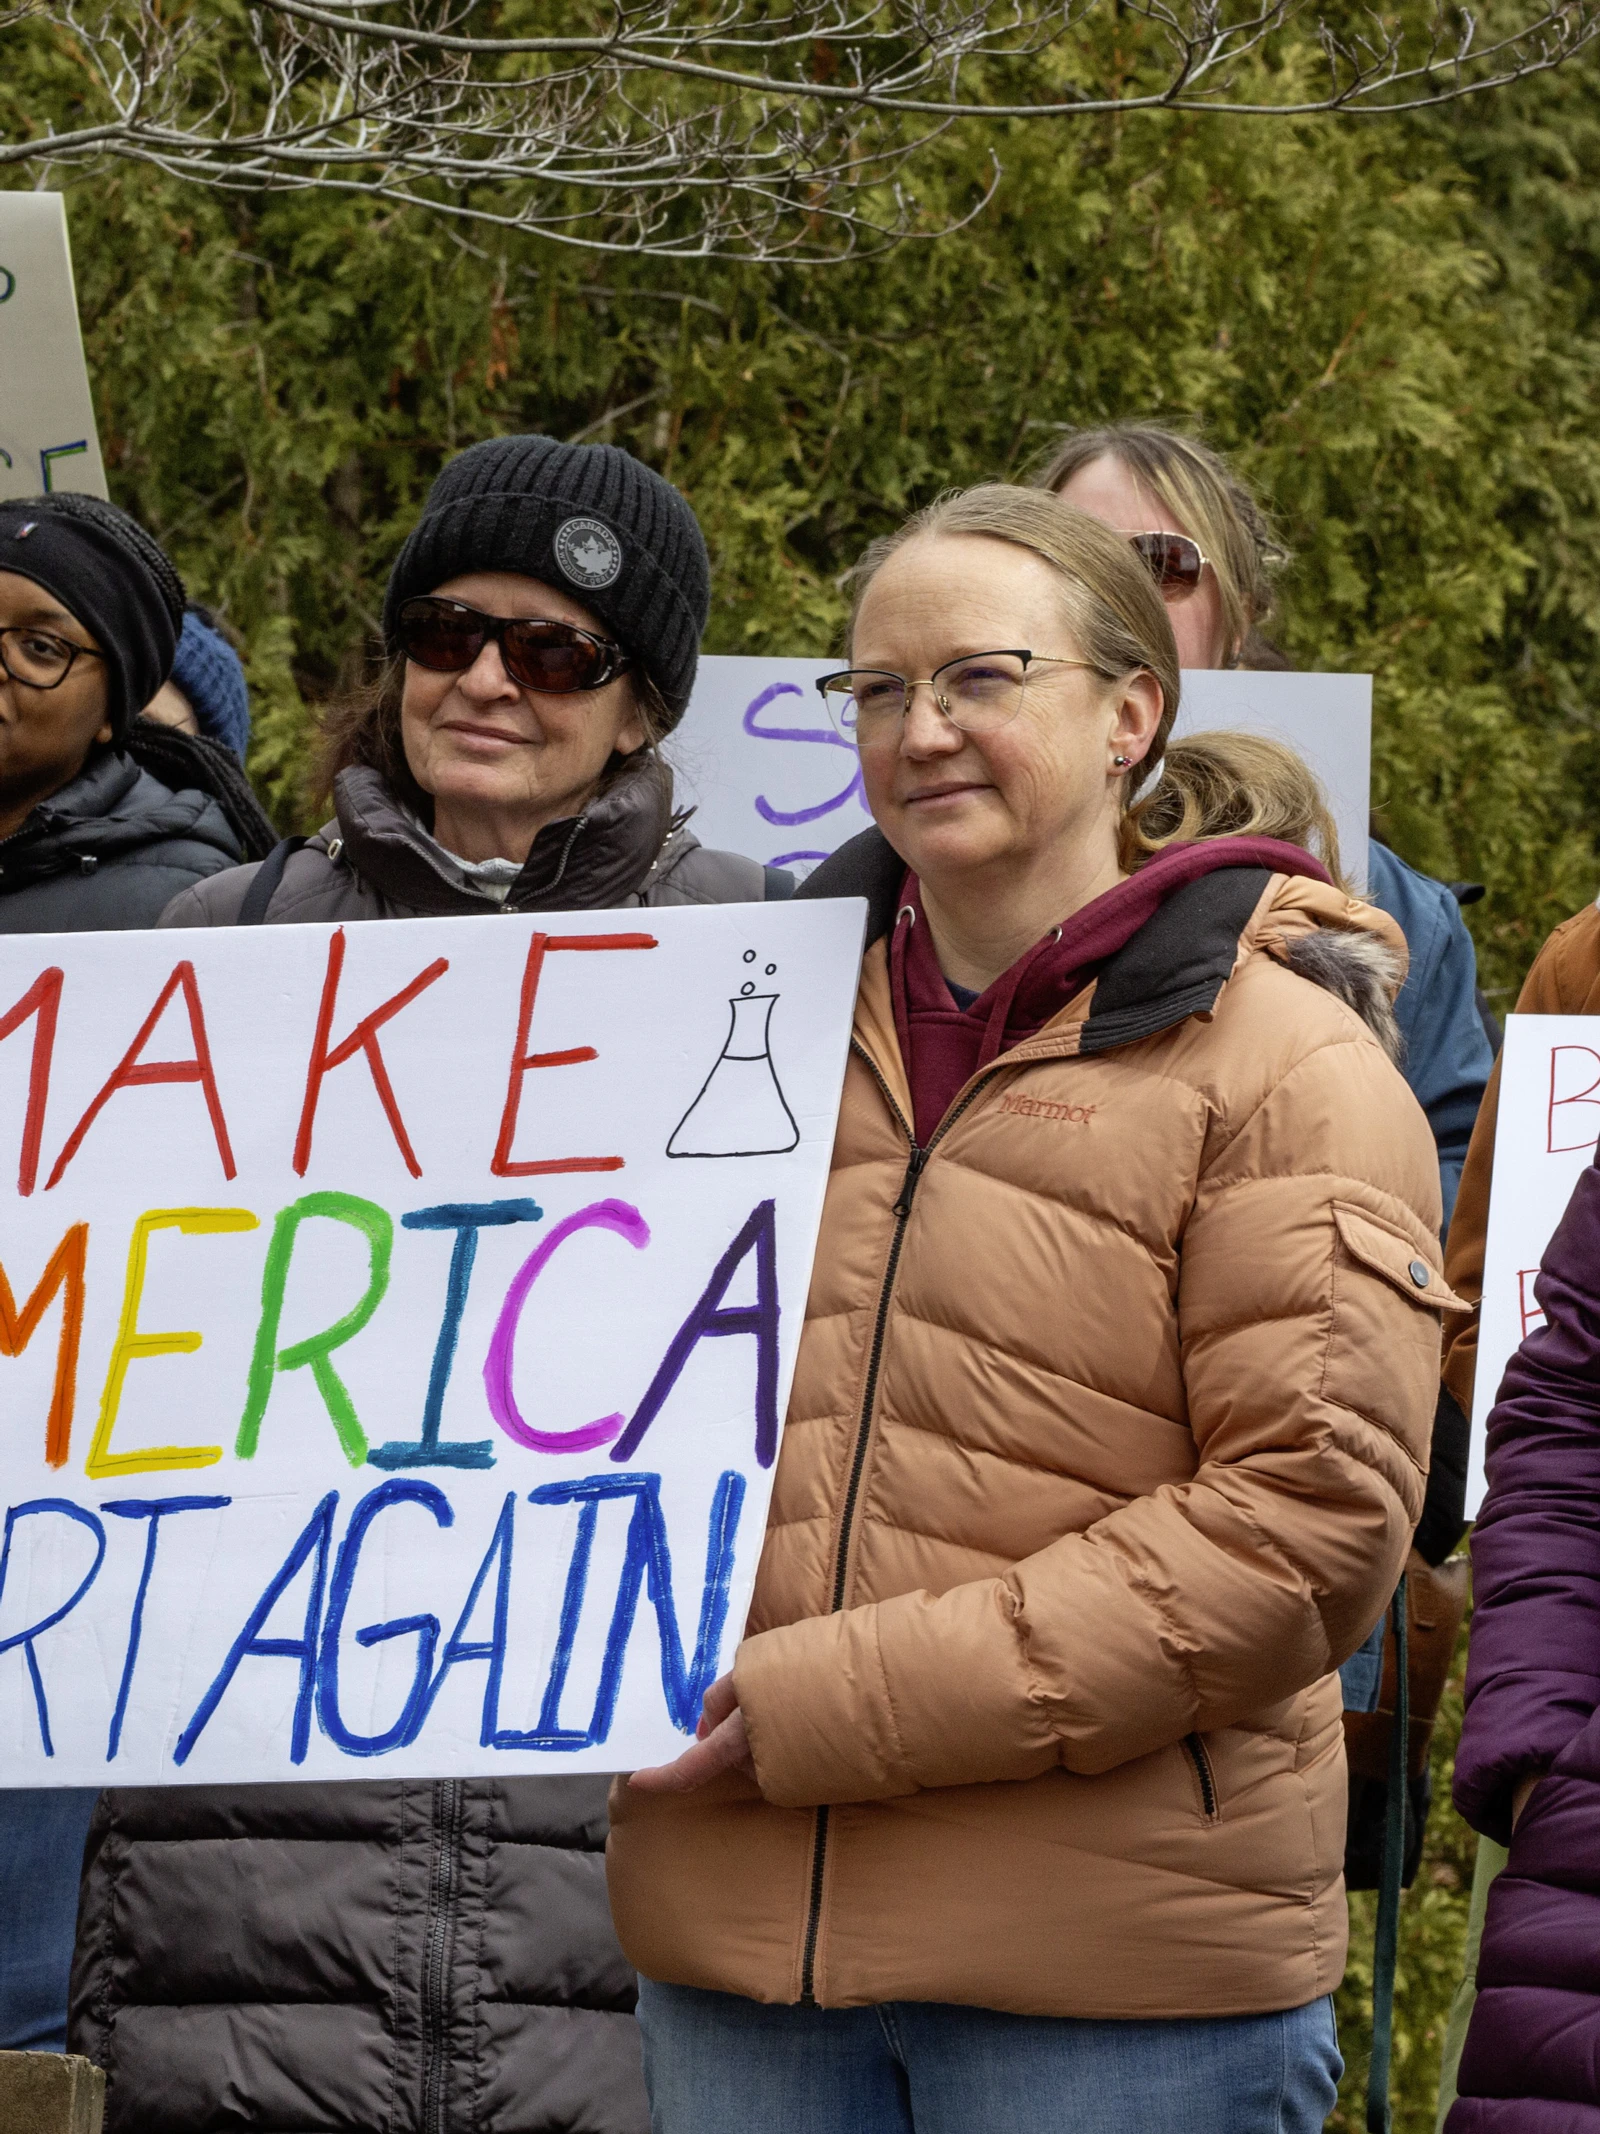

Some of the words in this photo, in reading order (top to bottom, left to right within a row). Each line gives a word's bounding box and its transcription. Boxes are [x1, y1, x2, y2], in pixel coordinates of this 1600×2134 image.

[571, 521, 614, 546] CANADA
[589, 573, 610, 586] gear
[997, 1093, 1096, 1124] Marmot
[173, 1470, 747, 1765] AGAIN
